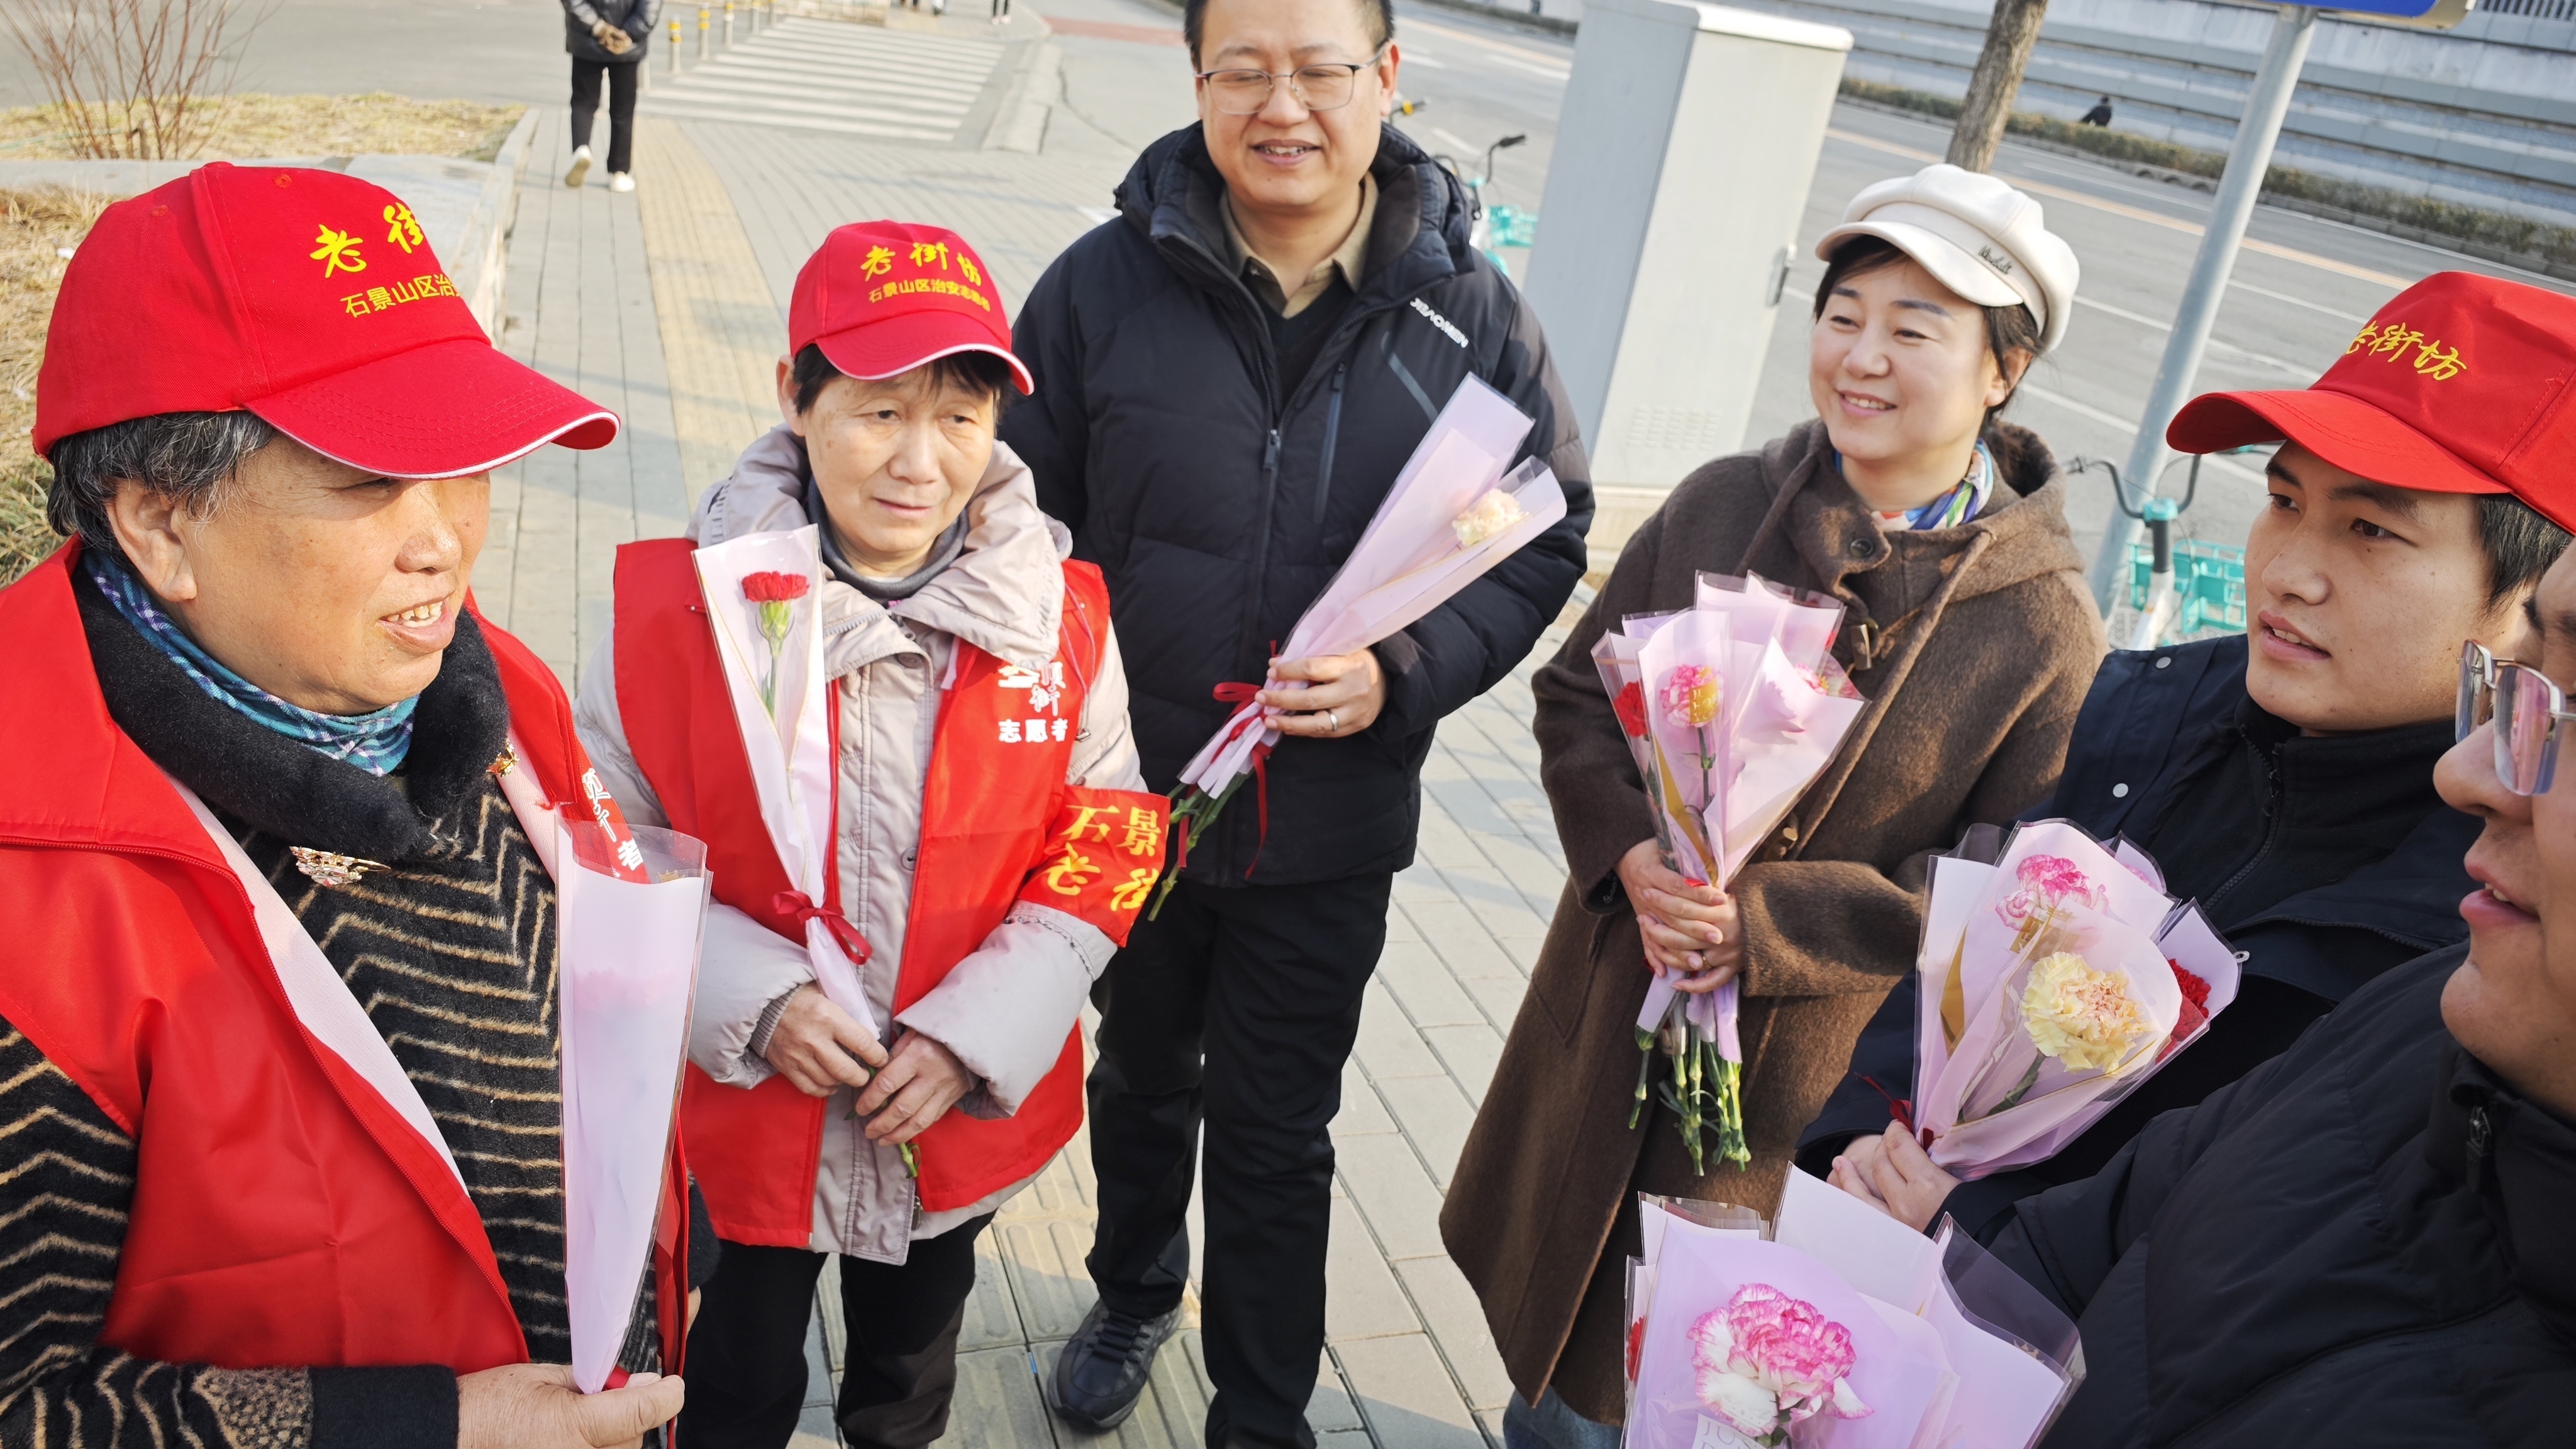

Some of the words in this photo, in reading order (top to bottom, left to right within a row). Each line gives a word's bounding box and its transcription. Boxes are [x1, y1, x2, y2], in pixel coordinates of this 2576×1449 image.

[860, 242, 982, 287] 老街坊
[340, 273, 461, 318] 石景山区治
[2345, 321, 2467, 381] 老街坊
[997, 718, 1068, 743] 志愿者
[1059, 804, 1162, 857] 石景
